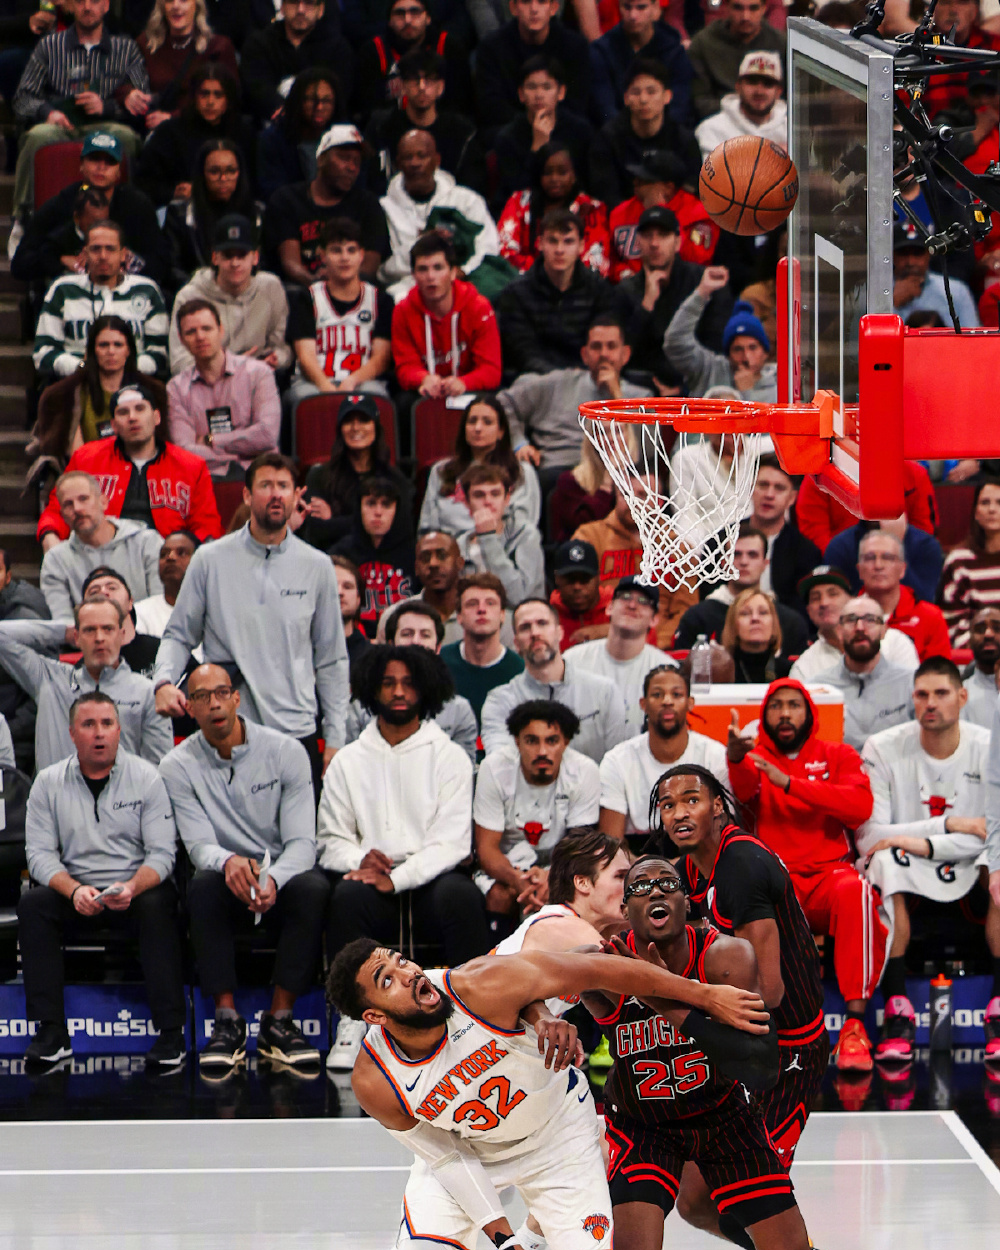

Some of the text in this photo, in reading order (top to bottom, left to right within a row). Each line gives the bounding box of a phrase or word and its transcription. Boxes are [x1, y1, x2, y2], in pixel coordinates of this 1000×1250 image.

[113, 800, 142, 811] Chicago
[251, 779, 279, 795] Chicago
[68, 1018, 160, 1038] Plus5
[616, 1015, 696, 1058] CHICA
[416, 1039, 509, 1121] NEW YORK
[632, 1050, 710, 1100] 25
[453, 1075, 527, 1131] 32
